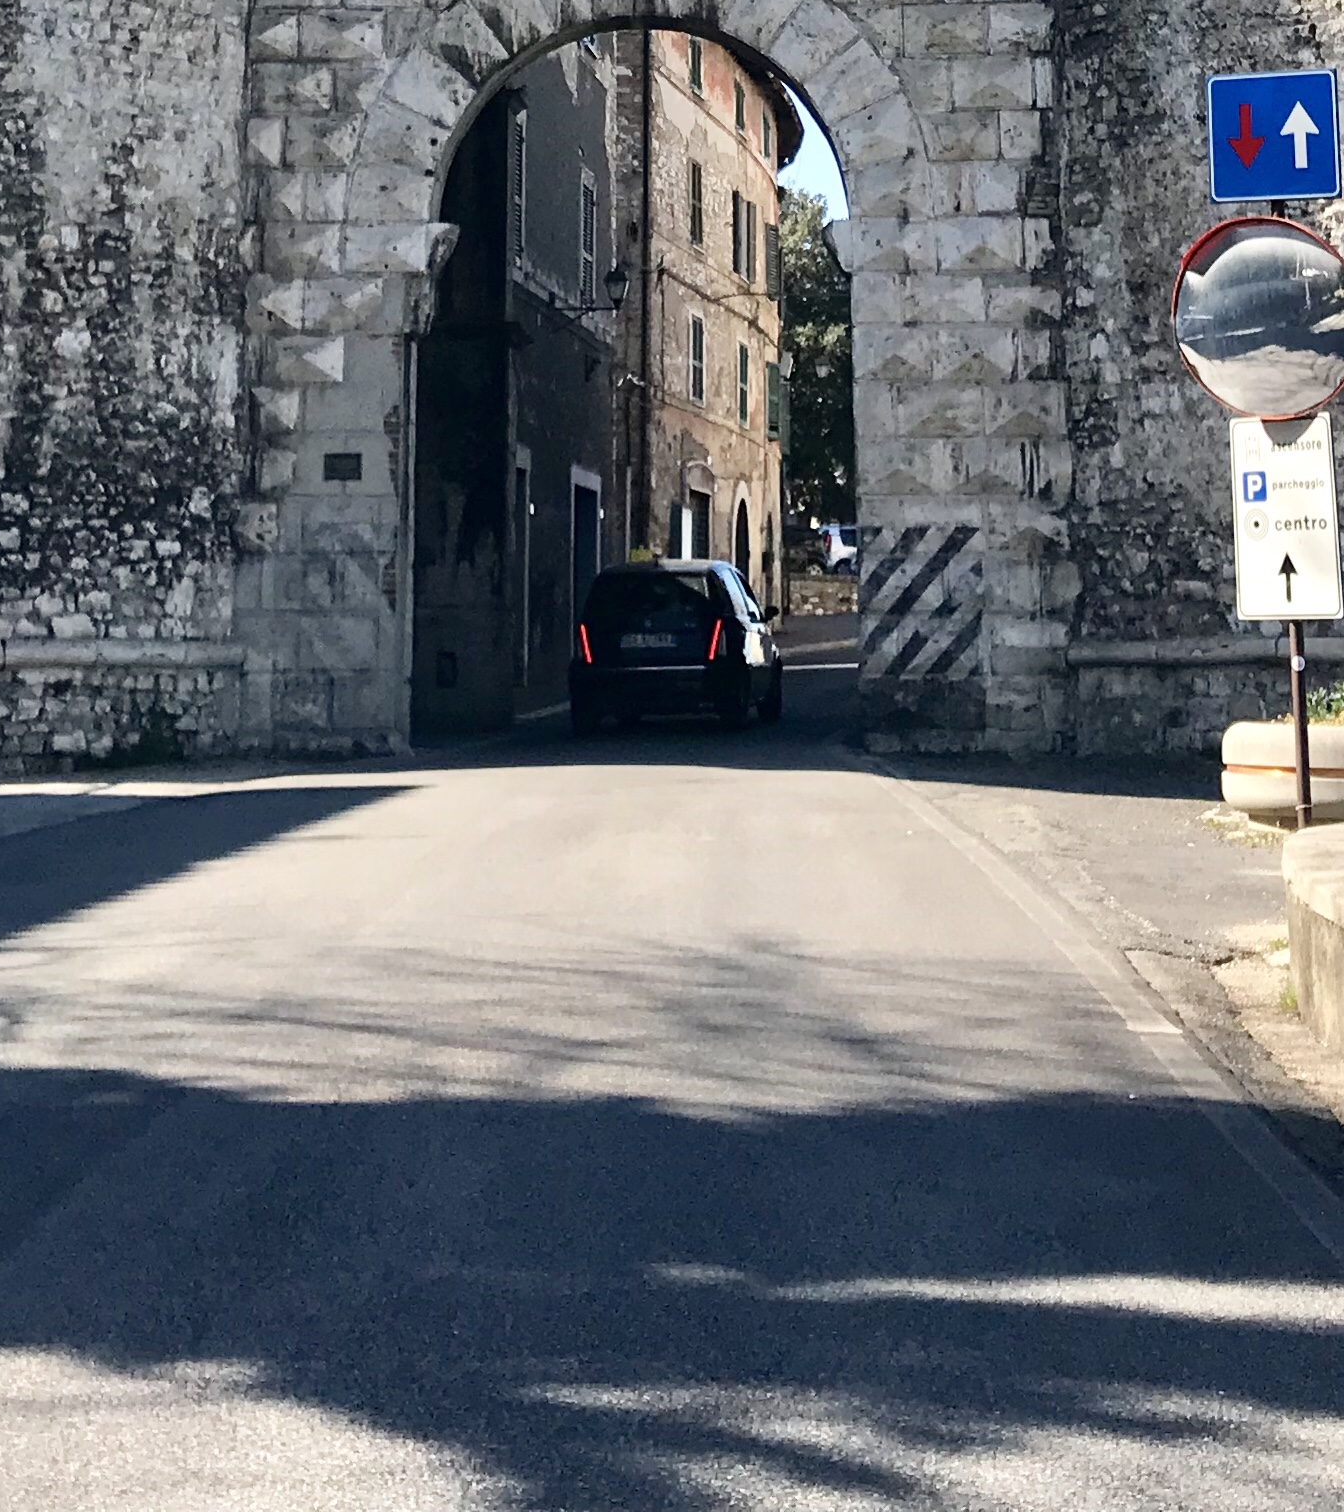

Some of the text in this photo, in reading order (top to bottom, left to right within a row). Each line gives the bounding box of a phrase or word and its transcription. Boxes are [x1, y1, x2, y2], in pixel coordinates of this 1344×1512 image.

[1247, 474, 1324, 500] P parcheggio
[1274, 515, 1328, 531] centro
